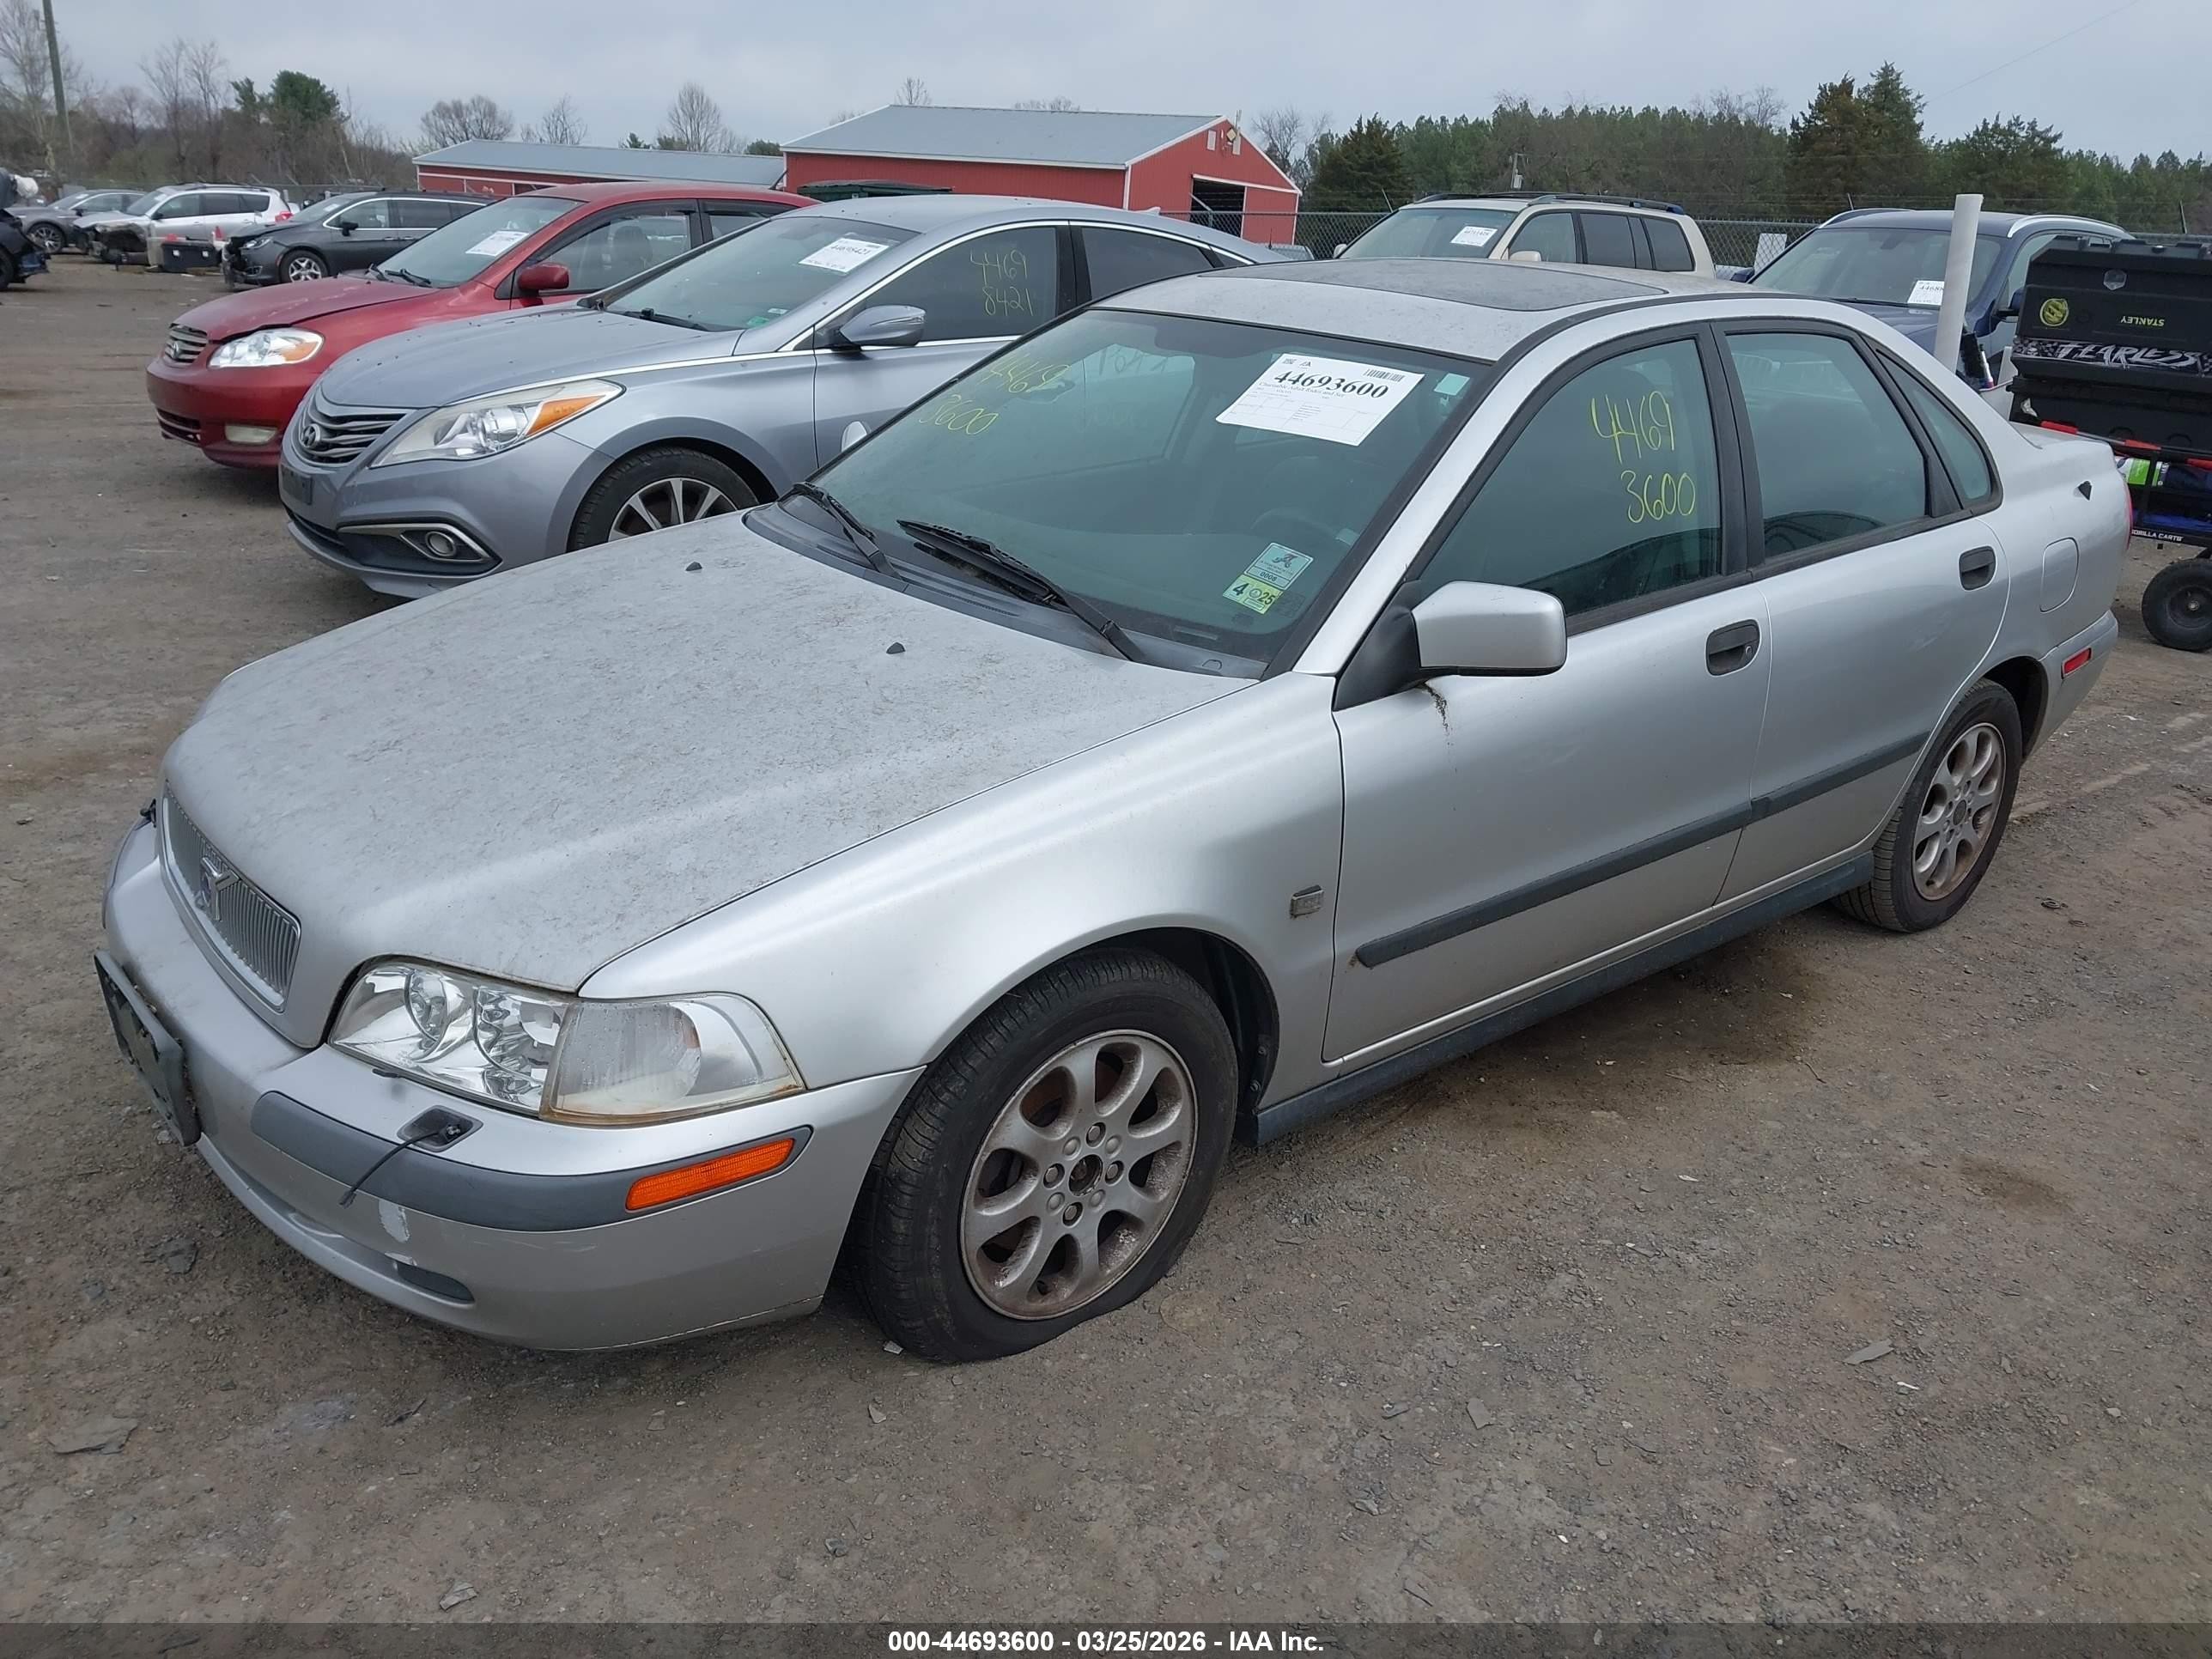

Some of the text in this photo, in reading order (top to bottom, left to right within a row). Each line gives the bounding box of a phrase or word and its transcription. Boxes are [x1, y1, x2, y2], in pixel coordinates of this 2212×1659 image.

[969, 249, 1028, 288] 4469
[982, 286, 1033, 316] 8421
[2120, 315, 2165, 326] STANLEY
[1274, 370, 1389, 398] 44693600
[1591, 391, 1675, 465] 4469
[1621, 470, 1696, 523] 3600
[1232, 583, 1277, 605] 4 25
